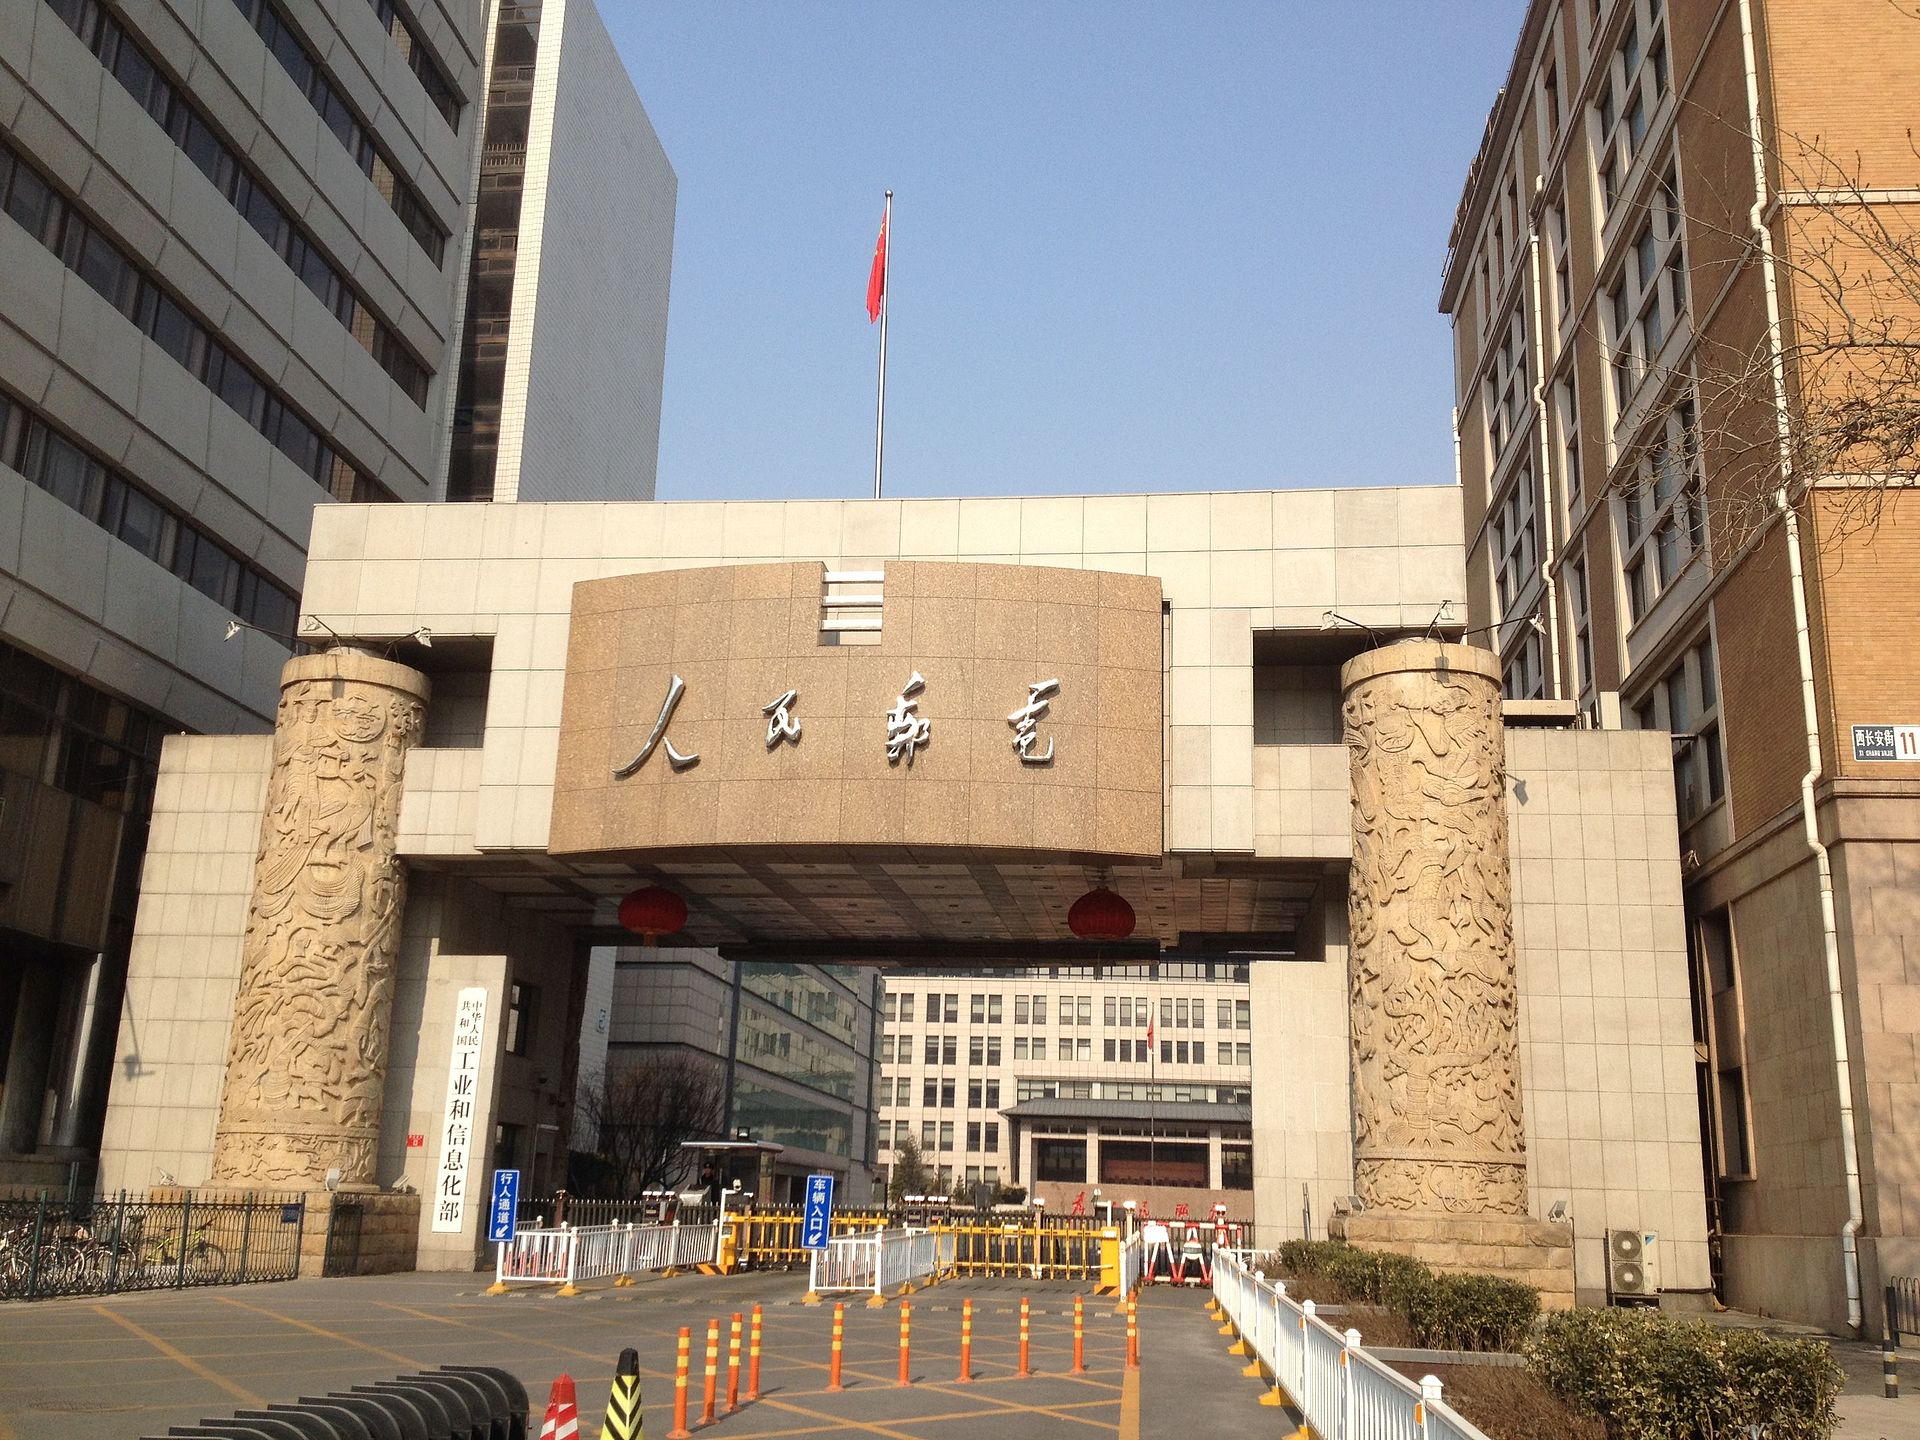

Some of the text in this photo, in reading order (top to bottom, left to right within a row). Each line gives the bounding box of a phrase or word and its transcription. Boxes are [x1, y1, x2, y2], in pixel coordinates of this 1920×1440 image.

[1855, 729, 1894, 747] 西长安街
[1900, 732, 1917, 754] 11
[456, 1001, 471, 1046] 共和国
[468, 1000, 482, 1046] 中华人民
[439, 1051, 475, 1222] 工业和信息化部
[497, 1173, 513, 1224] 行人通道
[810, 1179, 826, 1231] 车辆入口
